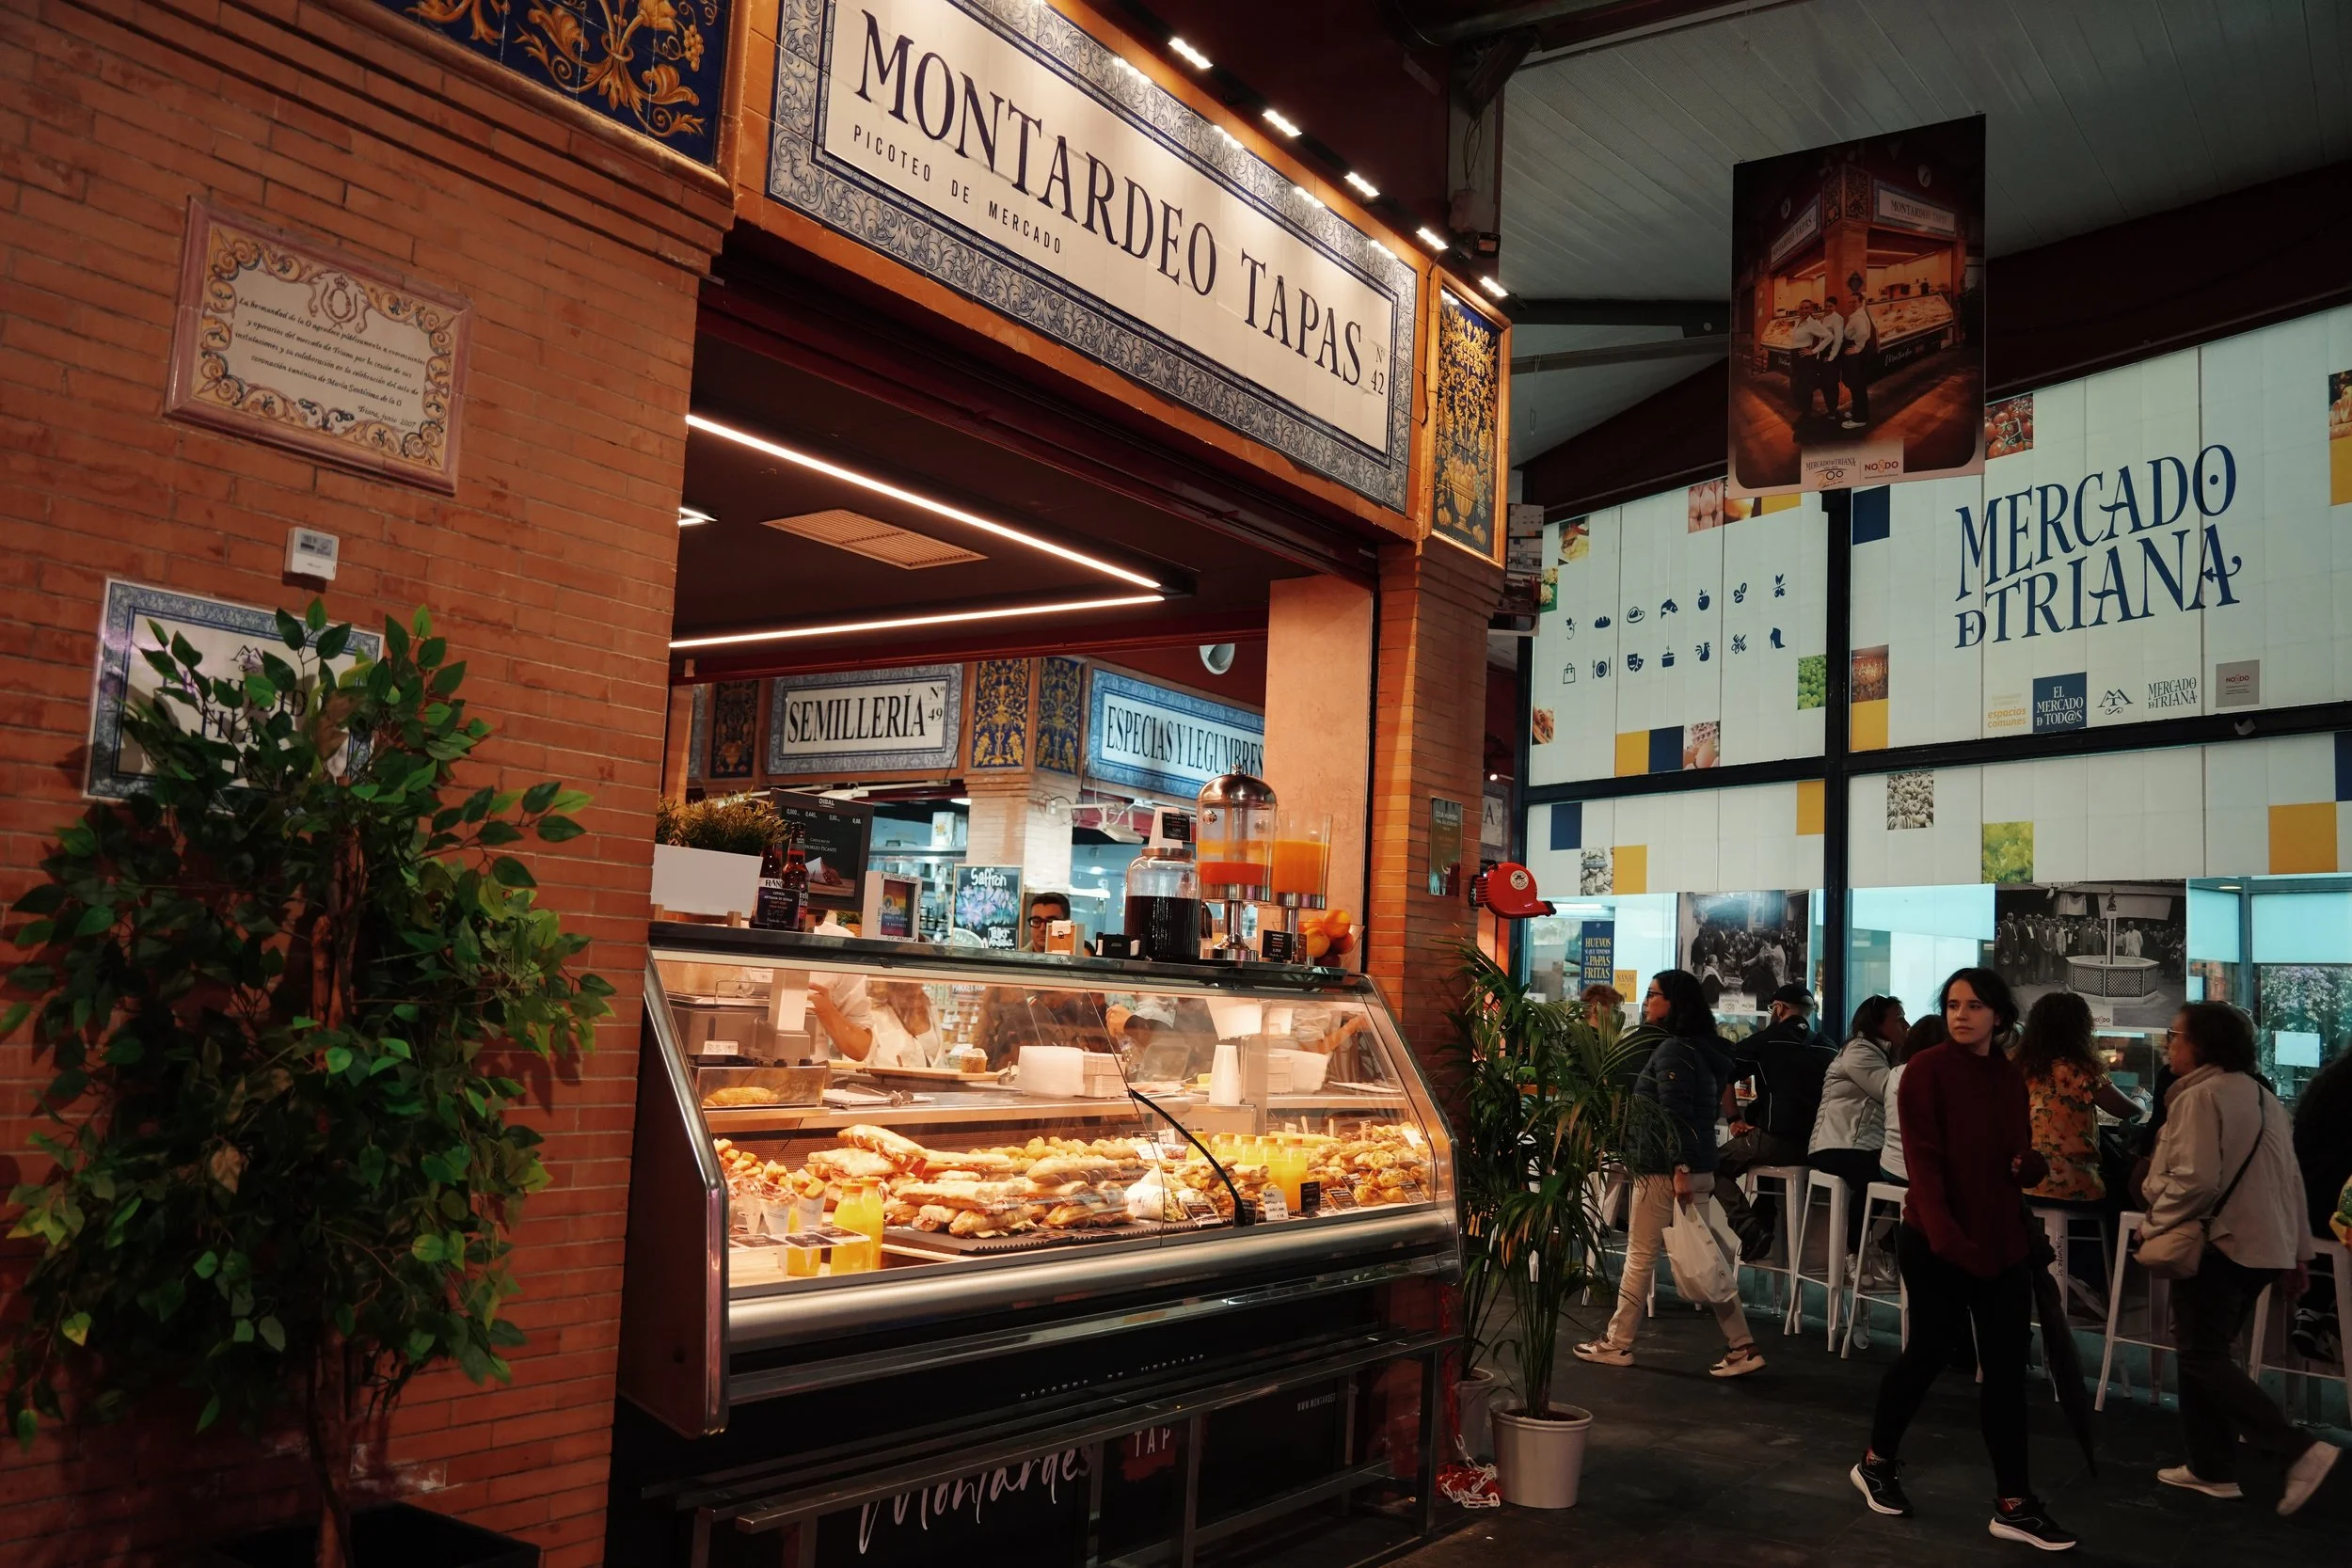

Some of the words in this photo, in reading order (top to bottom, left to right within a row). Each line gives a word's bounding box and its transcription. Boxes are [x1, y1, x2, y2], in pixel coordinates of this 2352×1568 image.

[853, 124, 931, 182] PICOTEO
[951, 178, 970, 205] DE
[989, 203, 1062, 255] MERCADO
[854, 9, 1218, 297] MONTARDEO
[1239, 248, 1361, 386] TAPAS
[239, 297, 248, 307] La
[249, 301, 287, 319] hermandad
[312, 324, 340, 337] agradece
[389, 349, 425, 366] comerciantes
[253, 323, 283, 336] operarios
[285, 331, 294, 340] del
[296, 336, 322, 348] mercado
[324, 343, 332, 352] de
[333, 347, 354, 359] Triana
[355, 356, 365, 364] por
[367, 357, 373, 366] la
[374, 362, 392, 372] cesión
[234, 331, 278, 351] instalaciones
[294, 352, 335, 370] colaboración
[387, 380, 396, 388] del
[397, 385, 410, 393] acto
[251, 356, 287, 371] coronación
[288, 366, 317, 381] canónica
[318, 374, 326, 383] de
[327, 377, 348, 390] María
[1371, 369, 1384, 395] 42
[380, 414, 397, 423] junio
[400, 419, 417, 429] 2007
[1955, 444, 2237, 602] MERCADO
[930, 686, 946, 700] Nº
[2053, 686, 2065, 698] EL
[2148, 677, 2197, 701] MERCADO
[928, 707, 943, 721] 49
[1988, 707, 2026, 720] espacios
[2037, 696, 2083, 713] MERCADO
[787, 689, 926, 743] SEMILLERÍA
[1988, 717, 2026, 728] comunes
[2043, 709, 2083, 726] TOD@S
[1106, 705, 1174, 764] ESPECIAS
[1176, 723, 1186, 765] Y
[1187, 726, 1263, 781] LEGUMBRES
[971, 867, 1007, 887] Saffron
[1585, 937, 1611, 948] HUEVOS
[1589, 956, 1611, 967] PAPAS
[1584, 968, 1611, 979] FRITAS
